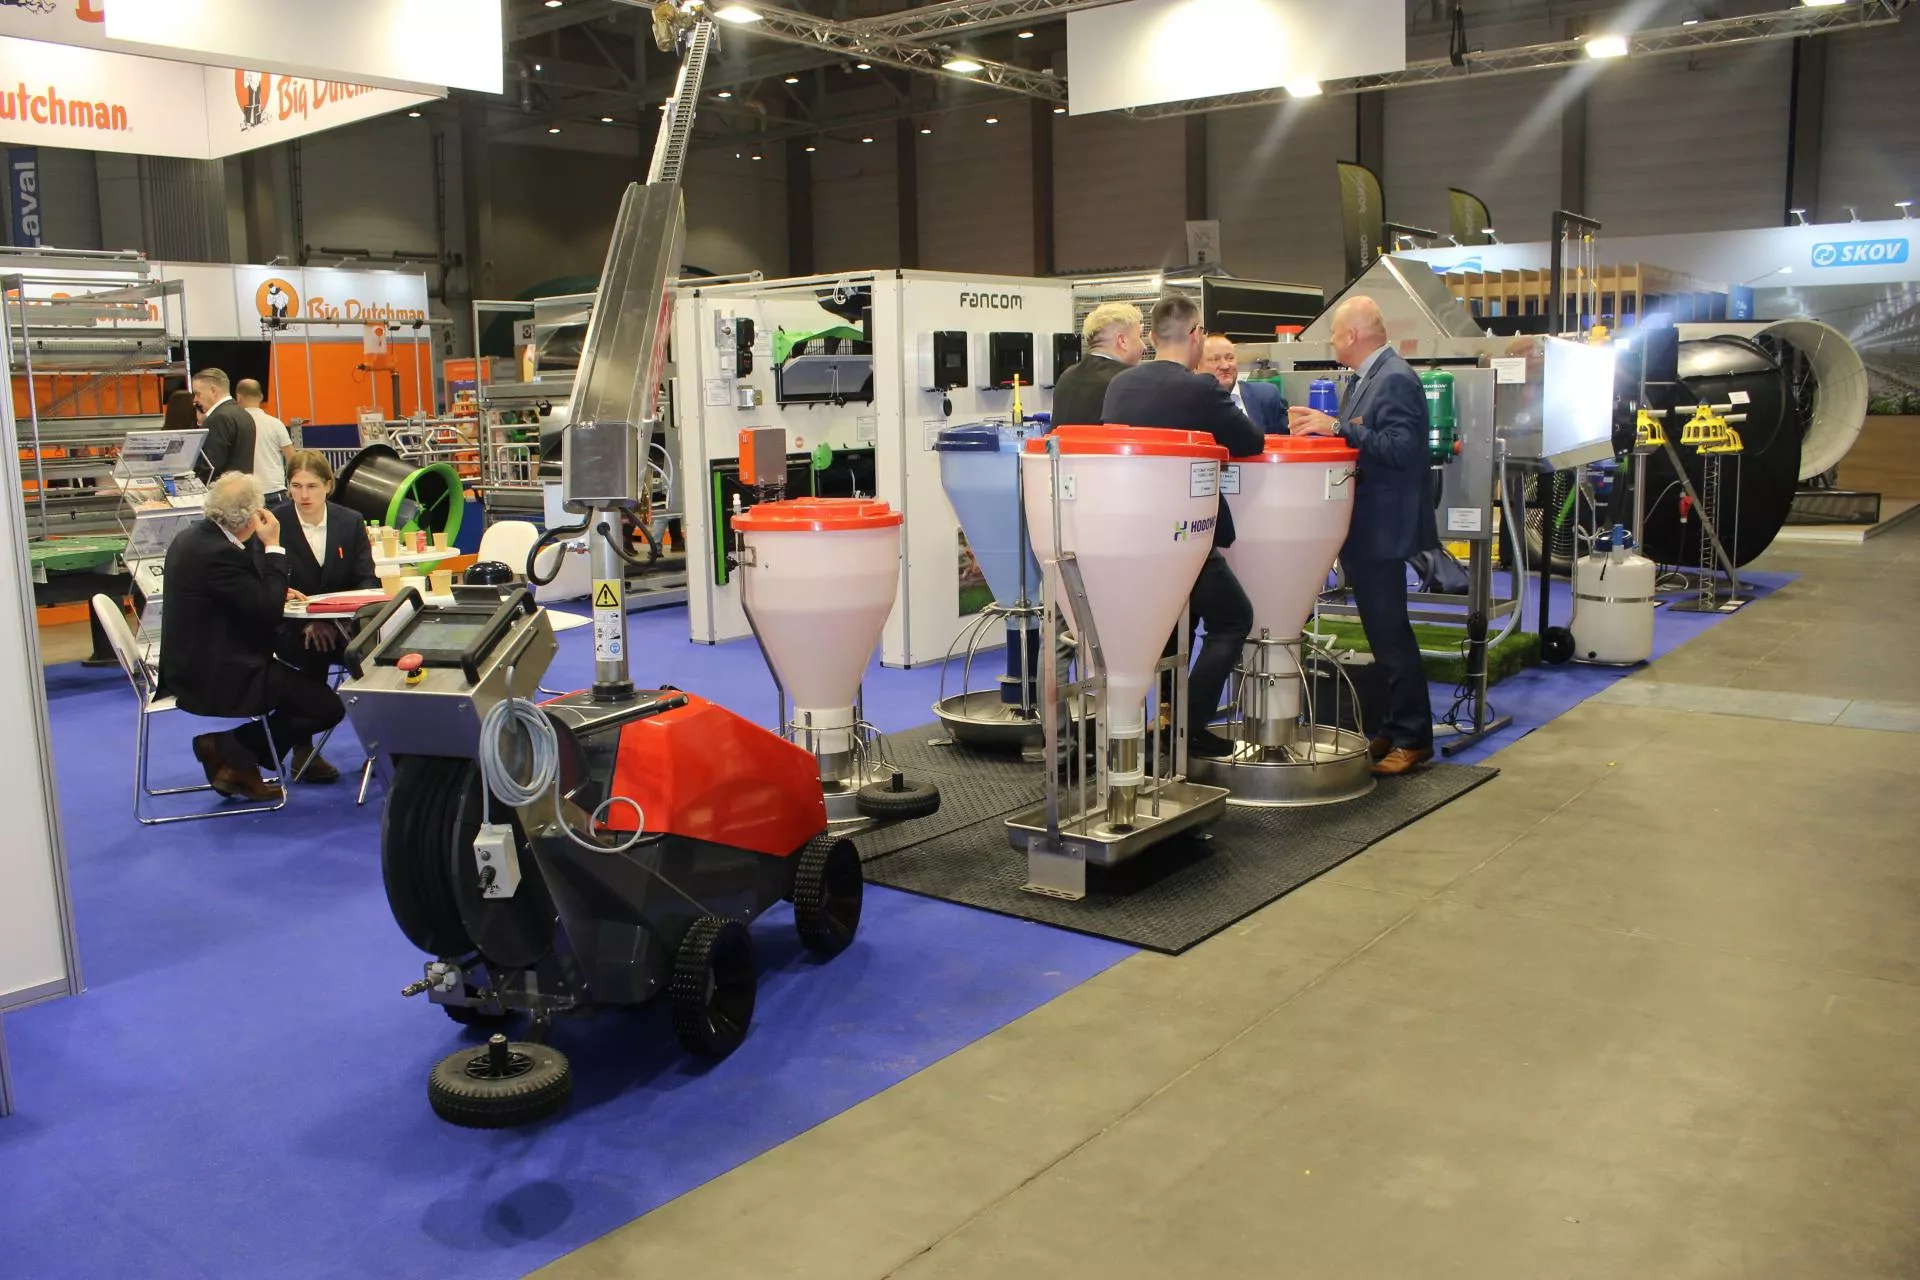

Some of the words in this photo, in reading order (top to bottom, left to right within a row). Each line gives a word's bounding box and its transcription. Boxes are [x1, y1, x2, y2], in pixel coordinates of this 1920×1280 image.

[277, 74, 308, 121] Big
[1840, 243, 1902, 262] SKOV
[307, 296, 341, 328] Big
[344, 299, 425, 321] Dutchman
